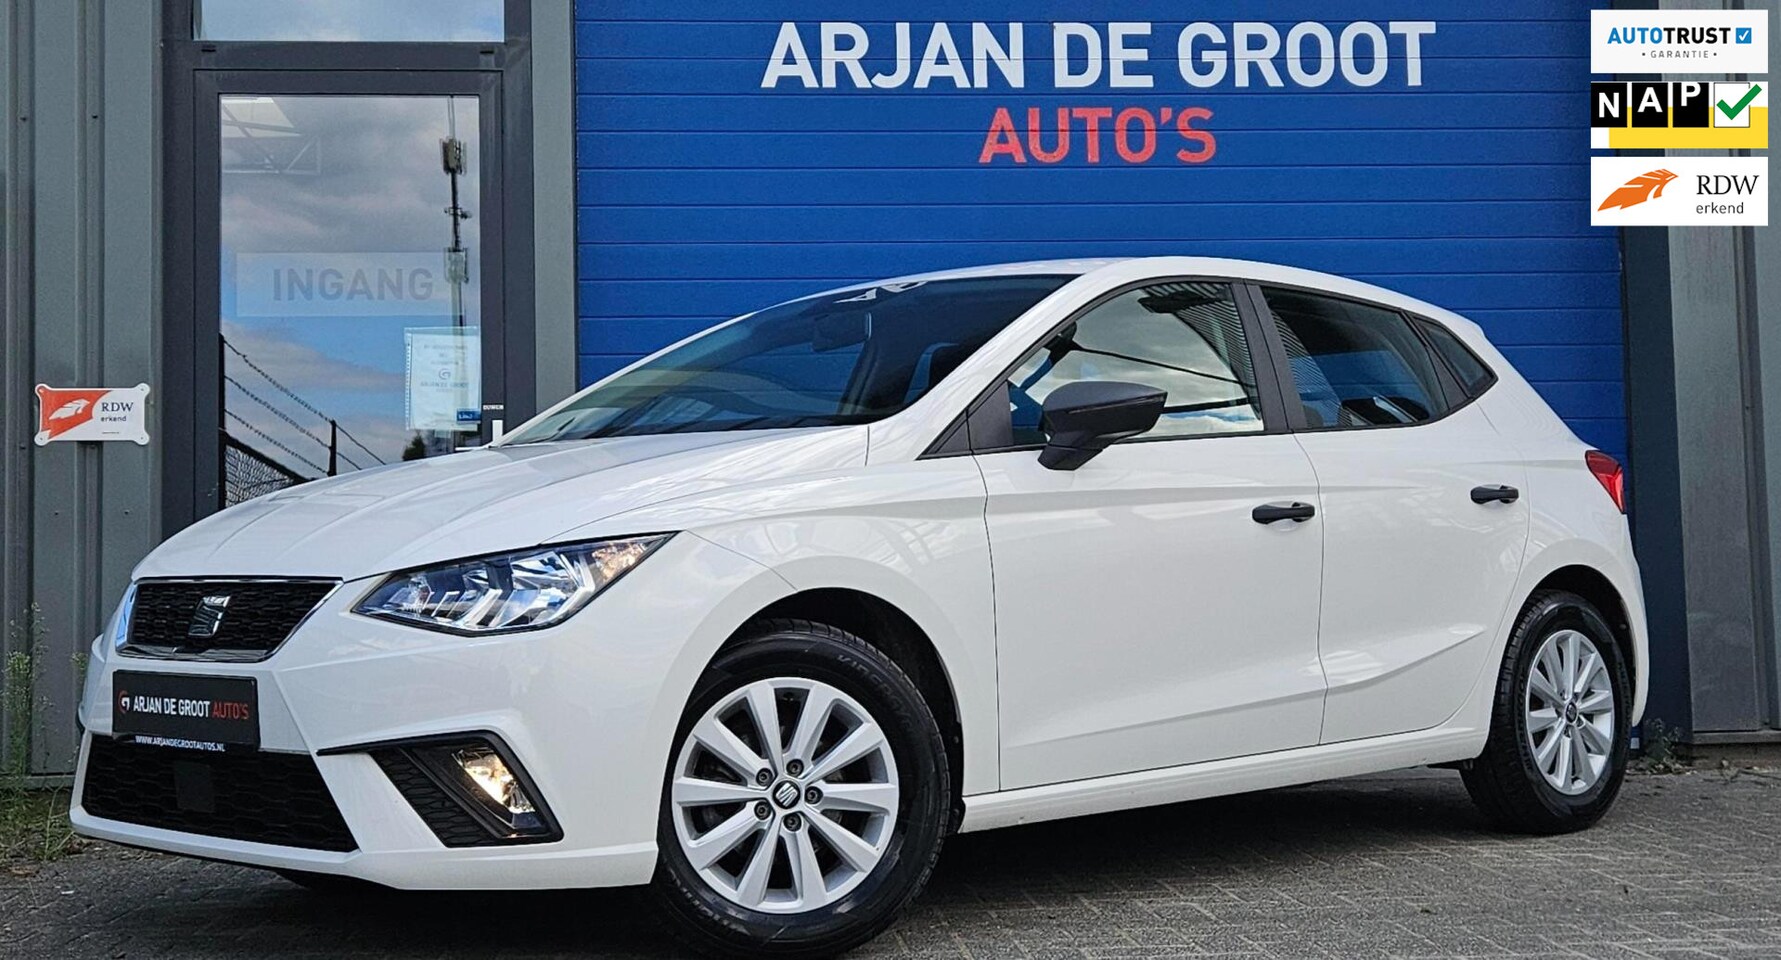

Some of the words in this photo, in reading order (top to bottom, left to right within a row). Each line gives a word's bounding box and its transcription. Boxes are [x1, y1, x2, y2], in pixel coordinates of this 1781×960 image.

[760, 21, 1025, 89] ARJAN
[1053, 22, 1155, 88] DE
[1177, 21, 1437, 89] GROOT
[980, 108, 1216, 163] AUTO'S
[273, 267, 434, 302] INGANG
[101, 402, 134, 412] RDW
[133, 695, 162, 714] ARJAN
[163, 698, 176, 715] DE
[178, 699, 210, 717] GROOT
[212, 701, 249, 720] AUTO'S
